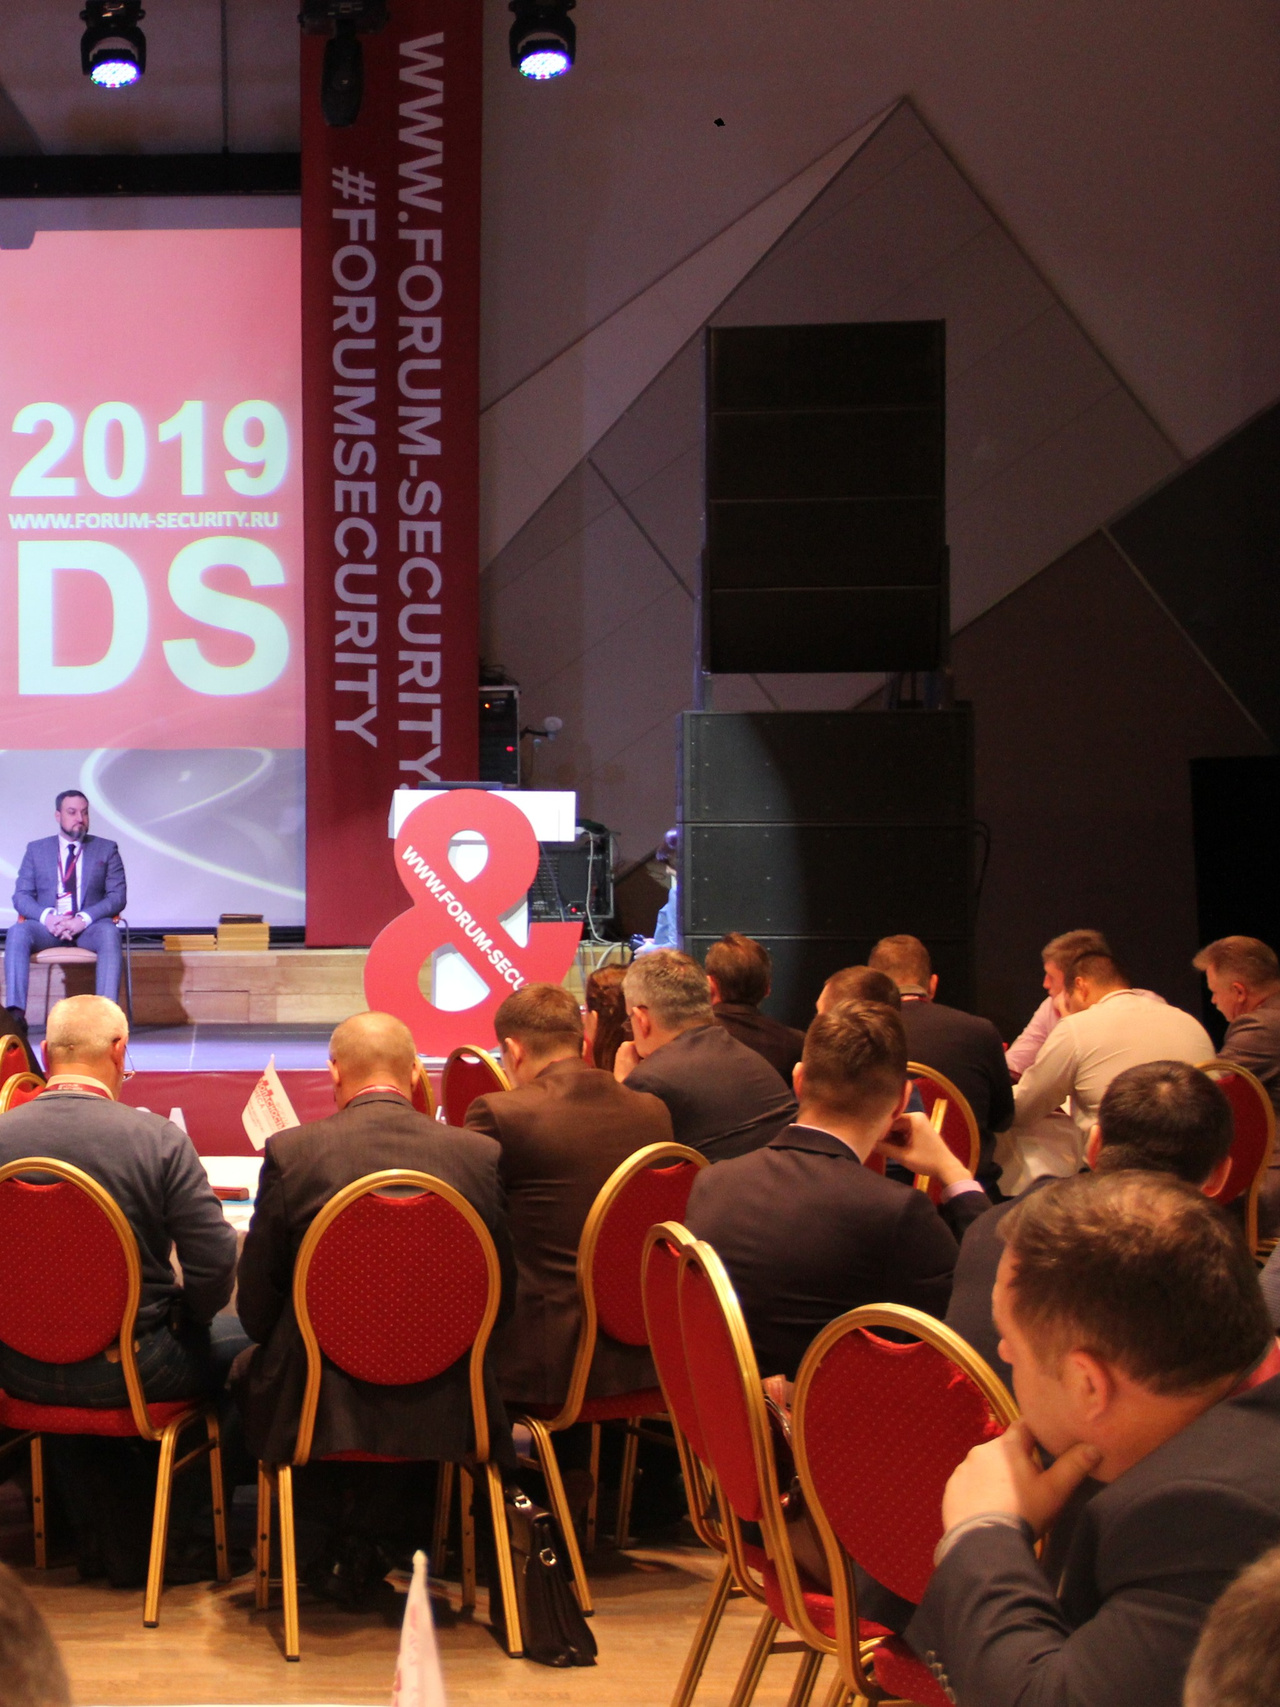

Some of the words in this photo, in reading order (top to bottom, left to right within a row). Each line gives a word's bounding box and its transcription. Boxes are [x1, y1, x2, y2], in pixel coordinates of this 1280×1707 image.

[9, 400, 290, 498] 2019
[331, 166, 378, 748] #FORUMSECURITY
[8, 511, 280, 530] WWW.FORUM-SECURITY.RU
